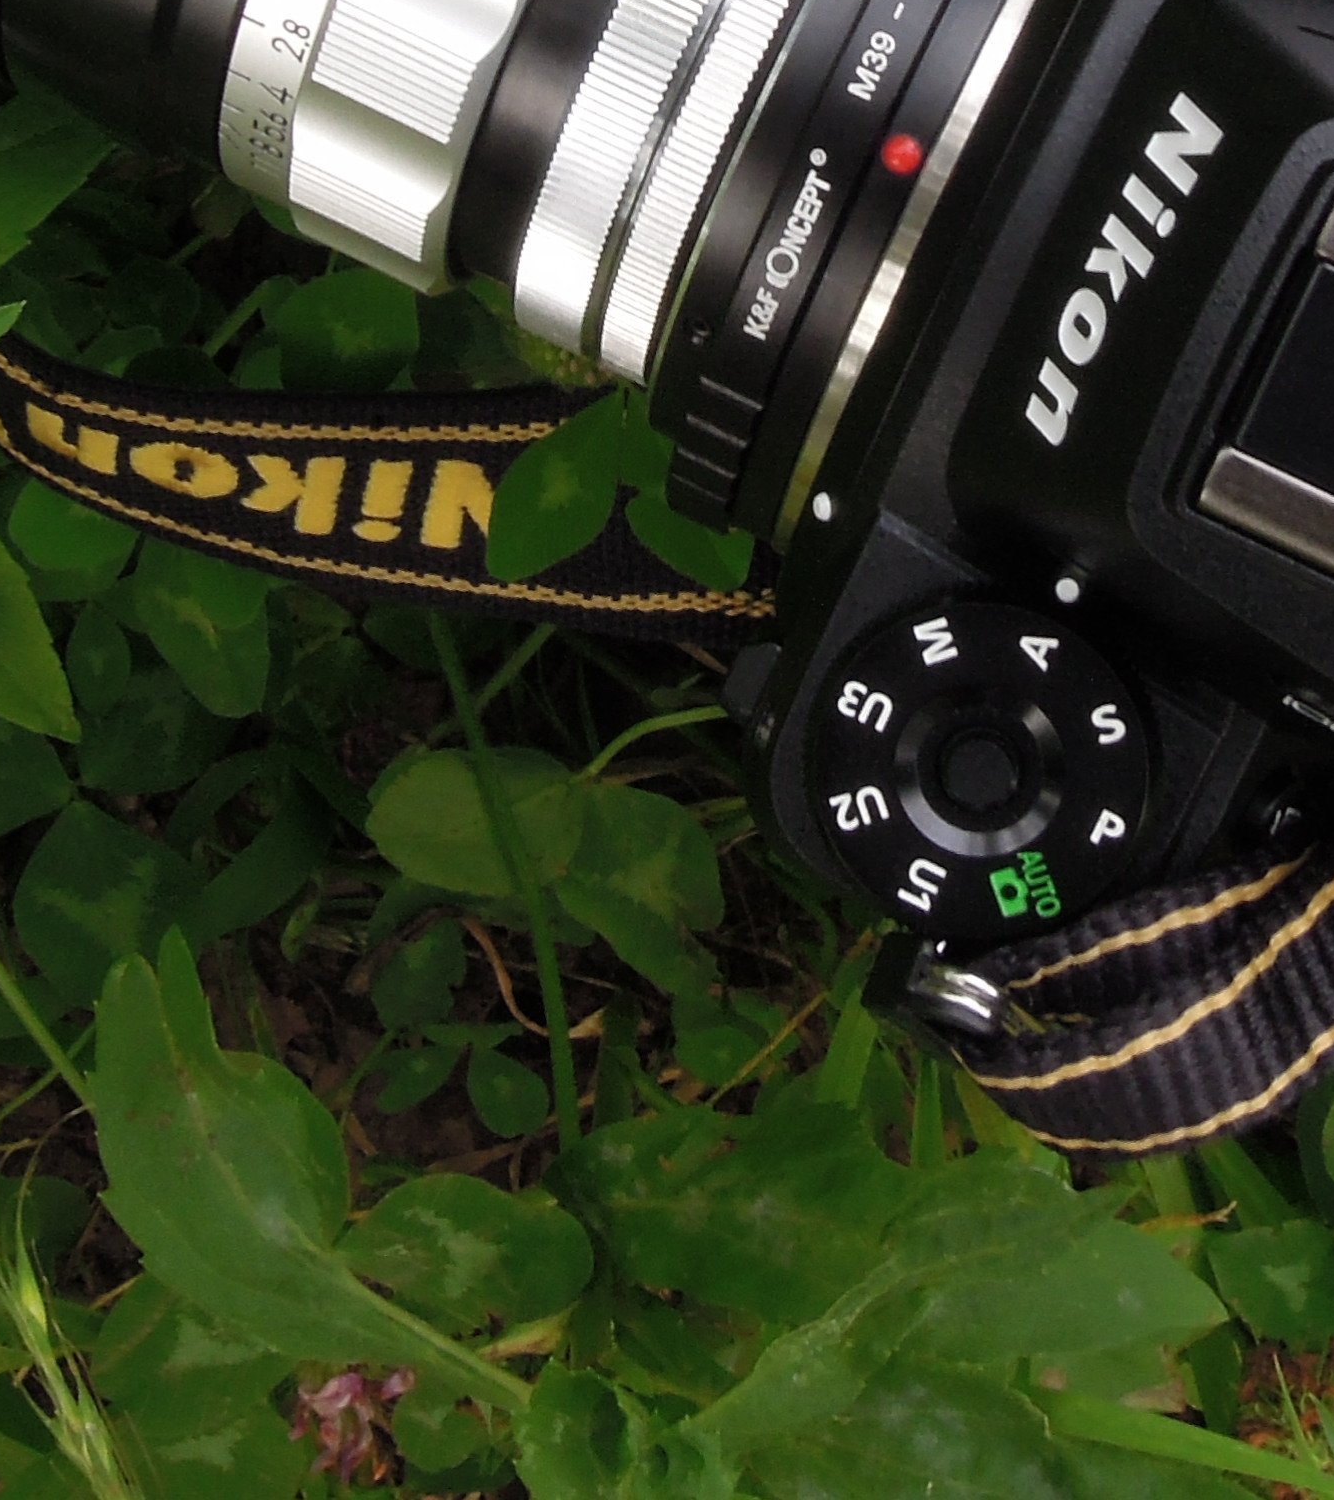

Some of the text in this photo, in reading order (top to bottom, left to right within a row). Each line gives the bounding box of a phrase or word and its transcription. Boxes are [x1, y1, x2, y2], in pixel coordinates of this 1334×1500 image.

[271, 19, 310, 63] 2.8
[846, 30, 897, 101] M39
[260, 82, 294, 105] 4
[1025, 91, 1224, 446] Nikon
[743, 287, 779, 341] K&F
[913, 616, 959, 666] M
[1019, 635, 1059, 672] A
[837, 680, 893, 733] U3
[1091, 704, 1126, 745] S
[828, 785, 890, 832] U2
[1089, 808, 1126, 845] P
[897, 858, 947, 912] U1
[1017, 851, 1061, 917] AUTO
